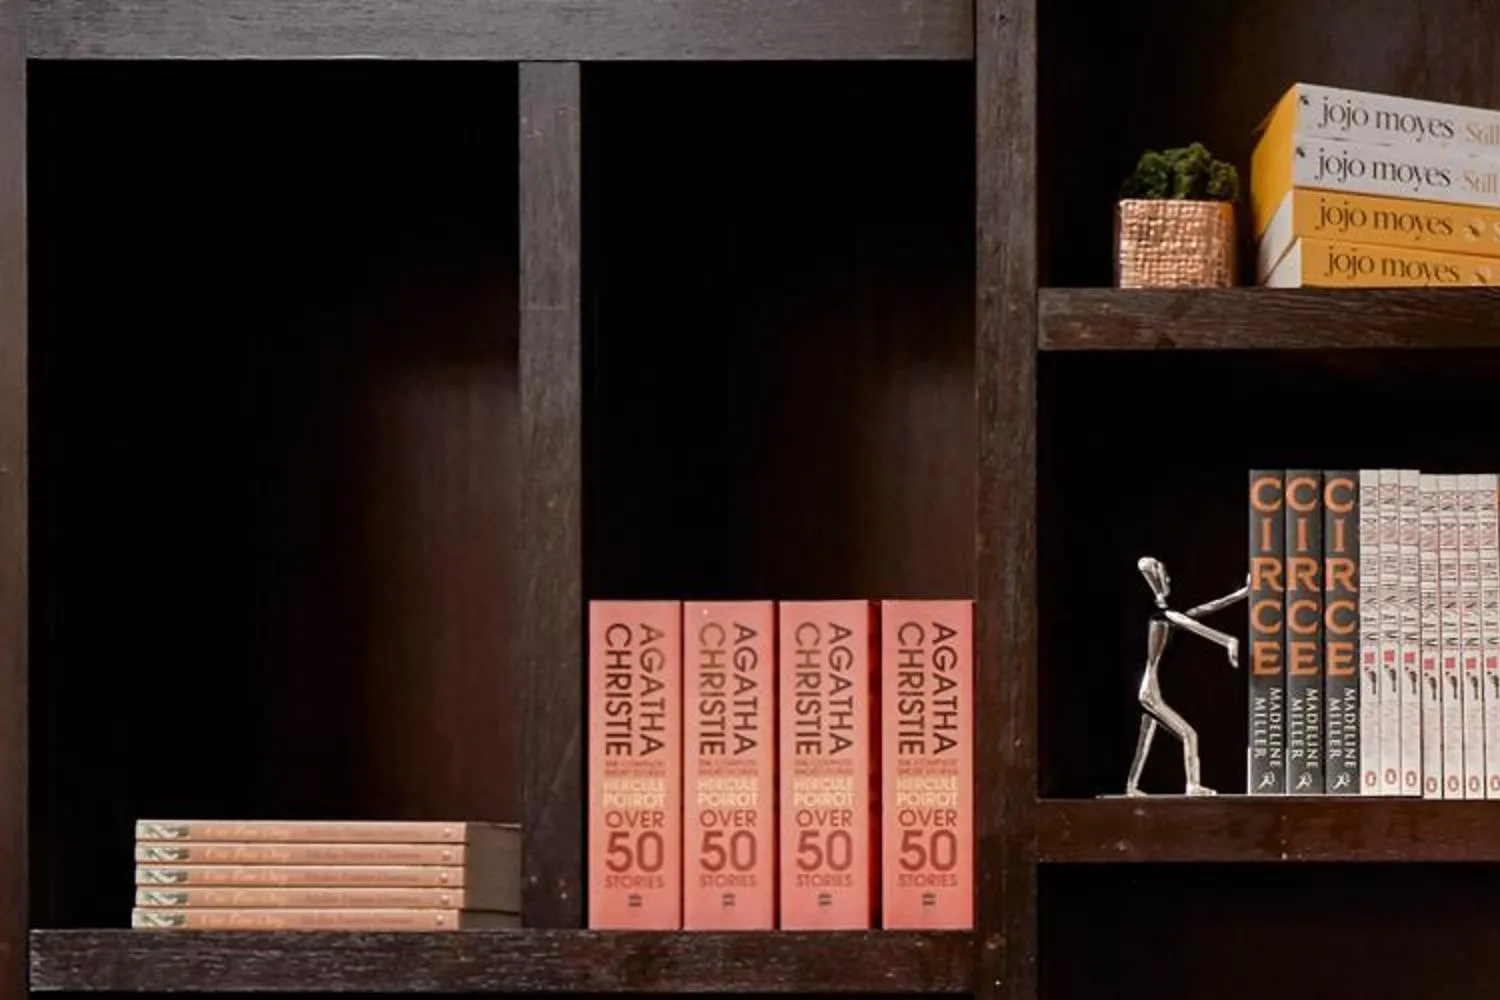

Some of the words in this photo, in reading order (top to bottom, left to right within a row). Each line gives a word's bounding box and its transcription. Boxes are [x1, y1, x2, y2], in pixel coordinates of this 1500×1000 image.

[1318, 96, 1368, 130] jojo
[1375, 113, 1455, 140] moyes
[1464, 121, 1499, 147] Still
[1315, 147, 1365, 182] jojo
[1372, 163, 1451, 191] moyes
[1462, 169, 1497, 195] Still
[1315, 198, 1366, 232] jojo
[1374, 213, 1454, 240] moyes
[1324, 246, 1375, 277] jojo
[1382, 260, 1461, 286] moyes
[1250, 477, 1283, 676] CIRCE
[1286, 477, 1321, 676] CIRCE
[1324, 477, 1356, 676] CIRCE
[605, 623, 632, 756] CHRISTIE
[640, 623, 664, 757] AGATHA
[700, 622, 725, 755] CHRISTIE
[733, 622, 758, 755] AGATHA
[795, 622, 821, 755] CHRISTIE
[829, 622, 853, 755] AGATHA
[898, 621, 924, 755] CHRISTIE
[932, 622, 958, 755] AGATHA
[1254, 698, 1267, 759] MILLER
[1269, 687, 1281, 767] MADELINE
[1291, 698, 1304, 759] MILLER
[1306, 687, 1318, 768] MADELINE
[1329, 698, 1342, 759] MILLER
[1343, 687, 1356, 768] MADELINE
[603, 793, 664, 808] POIROT
[605, 811, 664, 828] OVER
[698, 793, 757, 808] POIROT
[700, 809, 757, 827] OVER
[794, 792, 853, 807] POIROT
[796, 809, 853, 827] OVER
[897, 792, 958, 807] POIROT
[899, 809, 957, 827] OVER
[606, 831, 663, 872] 50
[700, 830, 757, 871] 50
[797, 830, 852, 871] 50
[899, 830, 957, 871] 50
[605, 875, 664, 889] STORIES
[700, 875, 756, 887] STORIES
[796, 874, 852, 887] STORIES
[899, 874, 957, 887] STORIES
